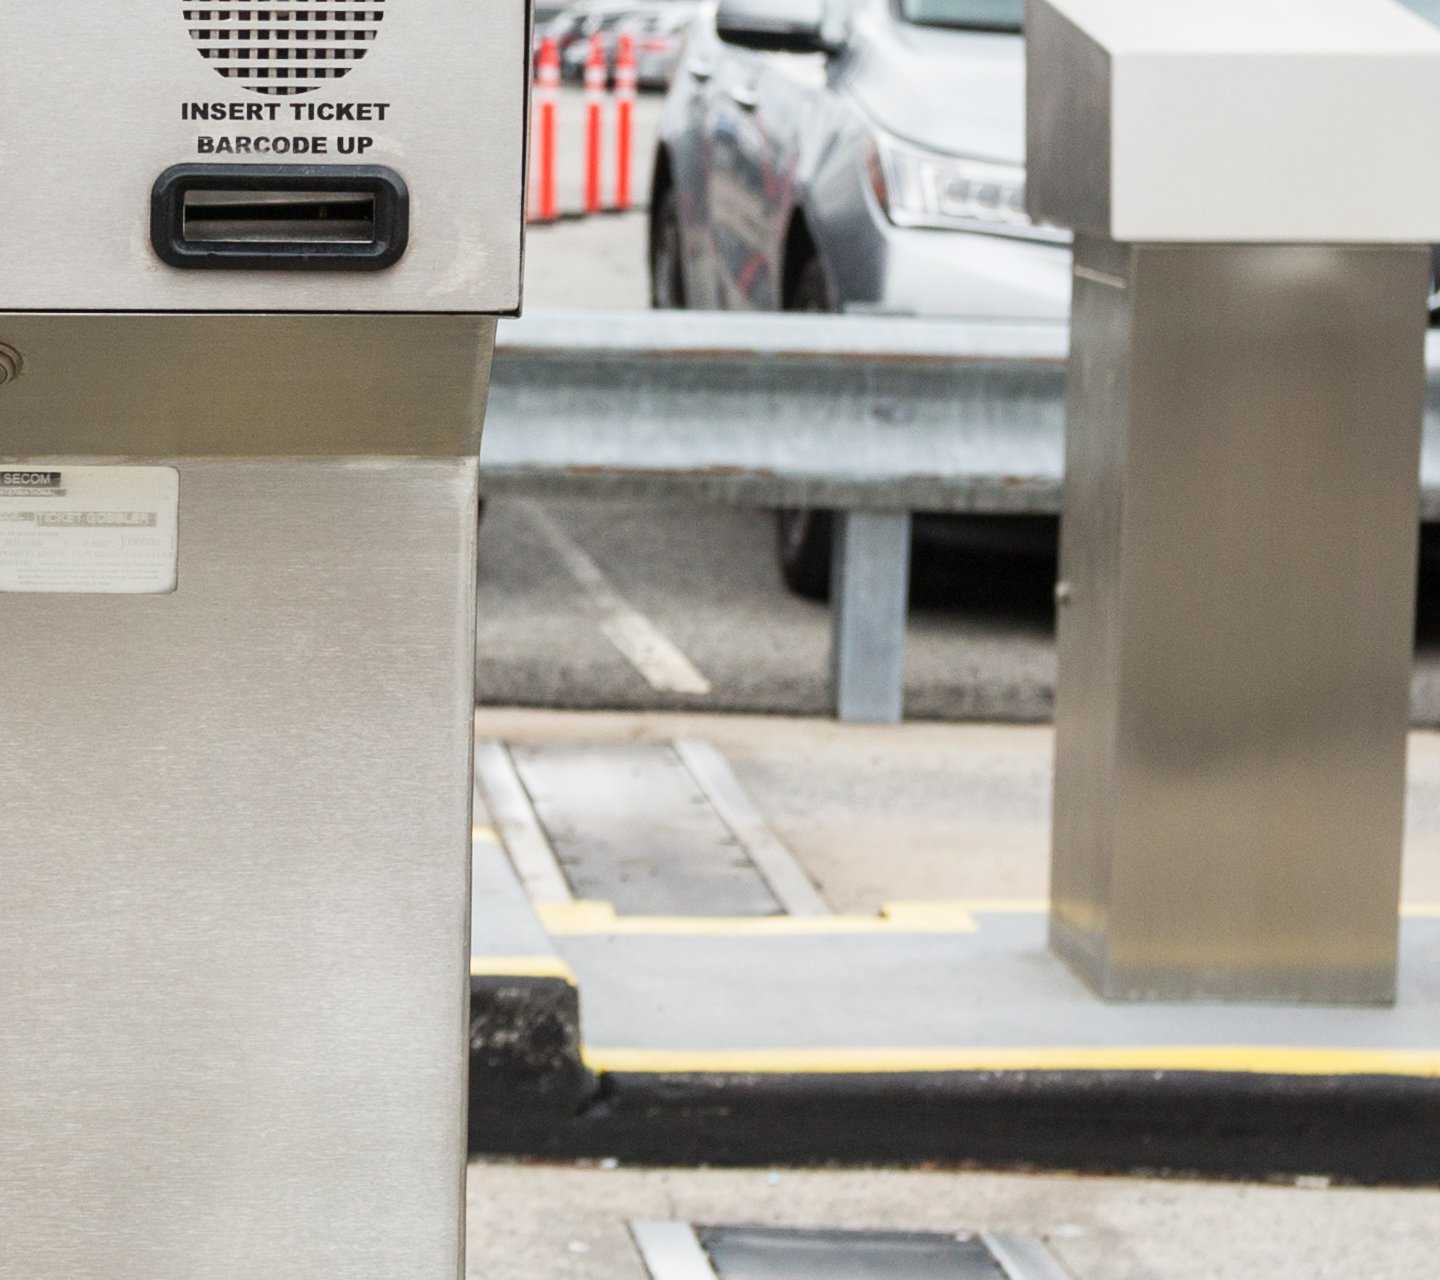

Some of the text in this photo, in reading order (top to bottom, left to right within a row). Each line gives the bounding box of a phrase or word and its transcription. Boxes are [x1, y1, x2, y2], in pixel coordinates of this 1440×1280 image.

[181, 102, 391, 121] INSERT TICKET
[197, 135, 374, 155] BARCODE UP
[3, 473, 51, 485] SECOM
